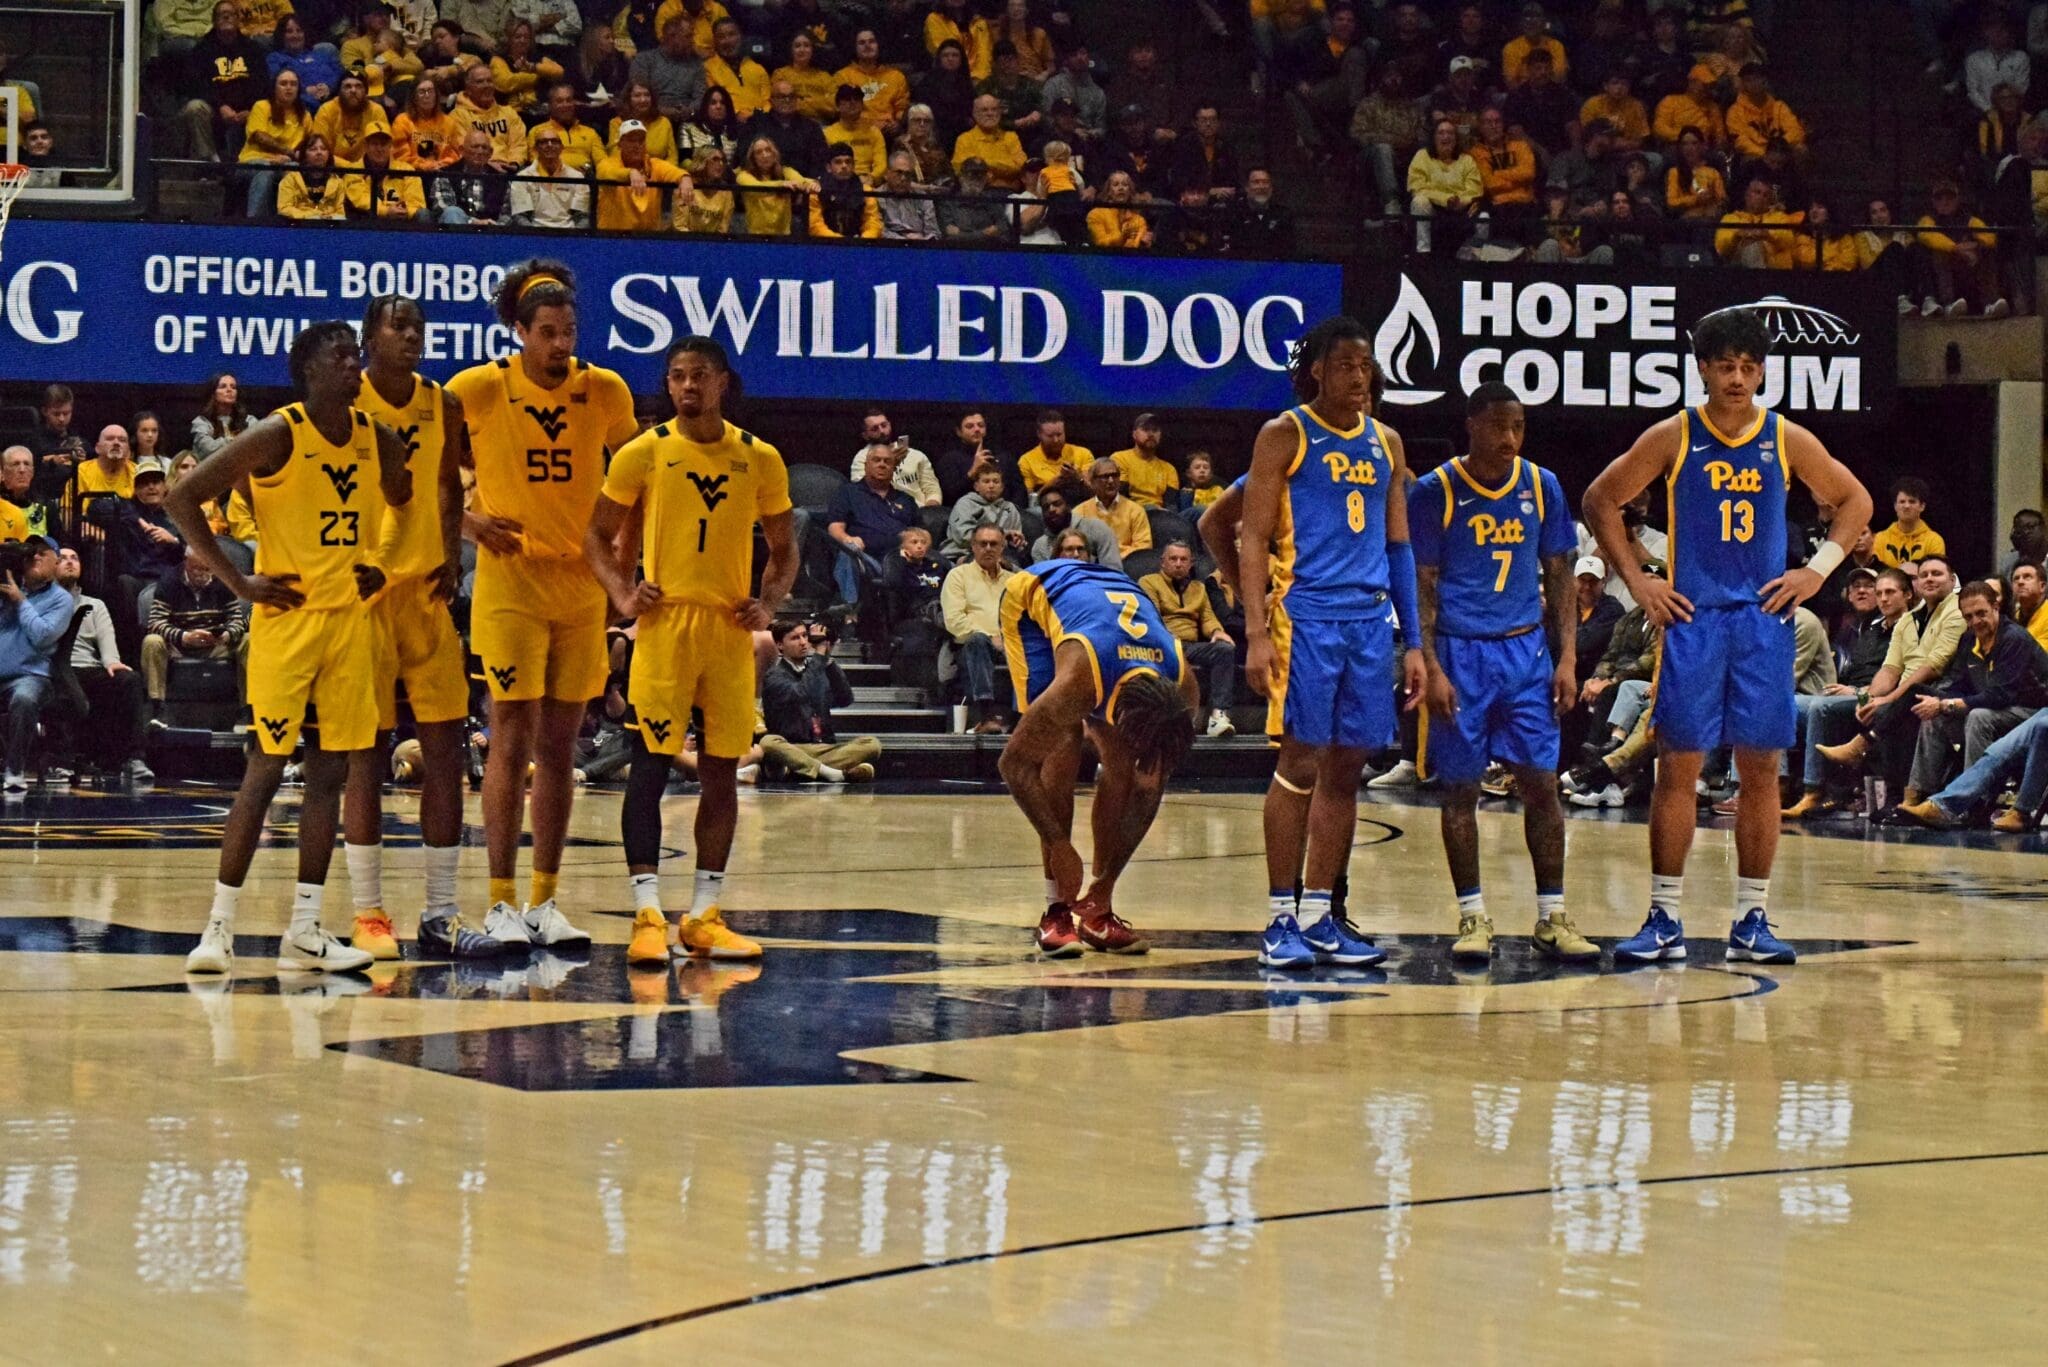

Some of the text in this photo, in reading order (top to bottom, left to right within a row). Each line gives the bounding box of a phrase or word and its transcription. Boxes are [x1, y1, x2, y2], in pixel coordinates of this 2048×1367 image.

[144, 254, 507, 303] OFFICIAL BOURBO
[607, 273, 1304, 372] SWILLED DOG
[1461, 281, 1677, 341] HOPE
[154, 314, 208, 354] OF
[527, 449, 573, 482] 55
[1322, 451, 1377, 486] Pitt
[1702, 460, 1763, 493] Pitt
[319, 510, 360, 547] 23
[1346, 490, 1366, 534] 8
[1467, 513, 1525, 546] Pitt
[1718, 499, 1755, 543] 13
[698, 517, 708, 553] 1
[1492, 550, 1513, 592] 7
[1104, 590, 1149, 640] 2
